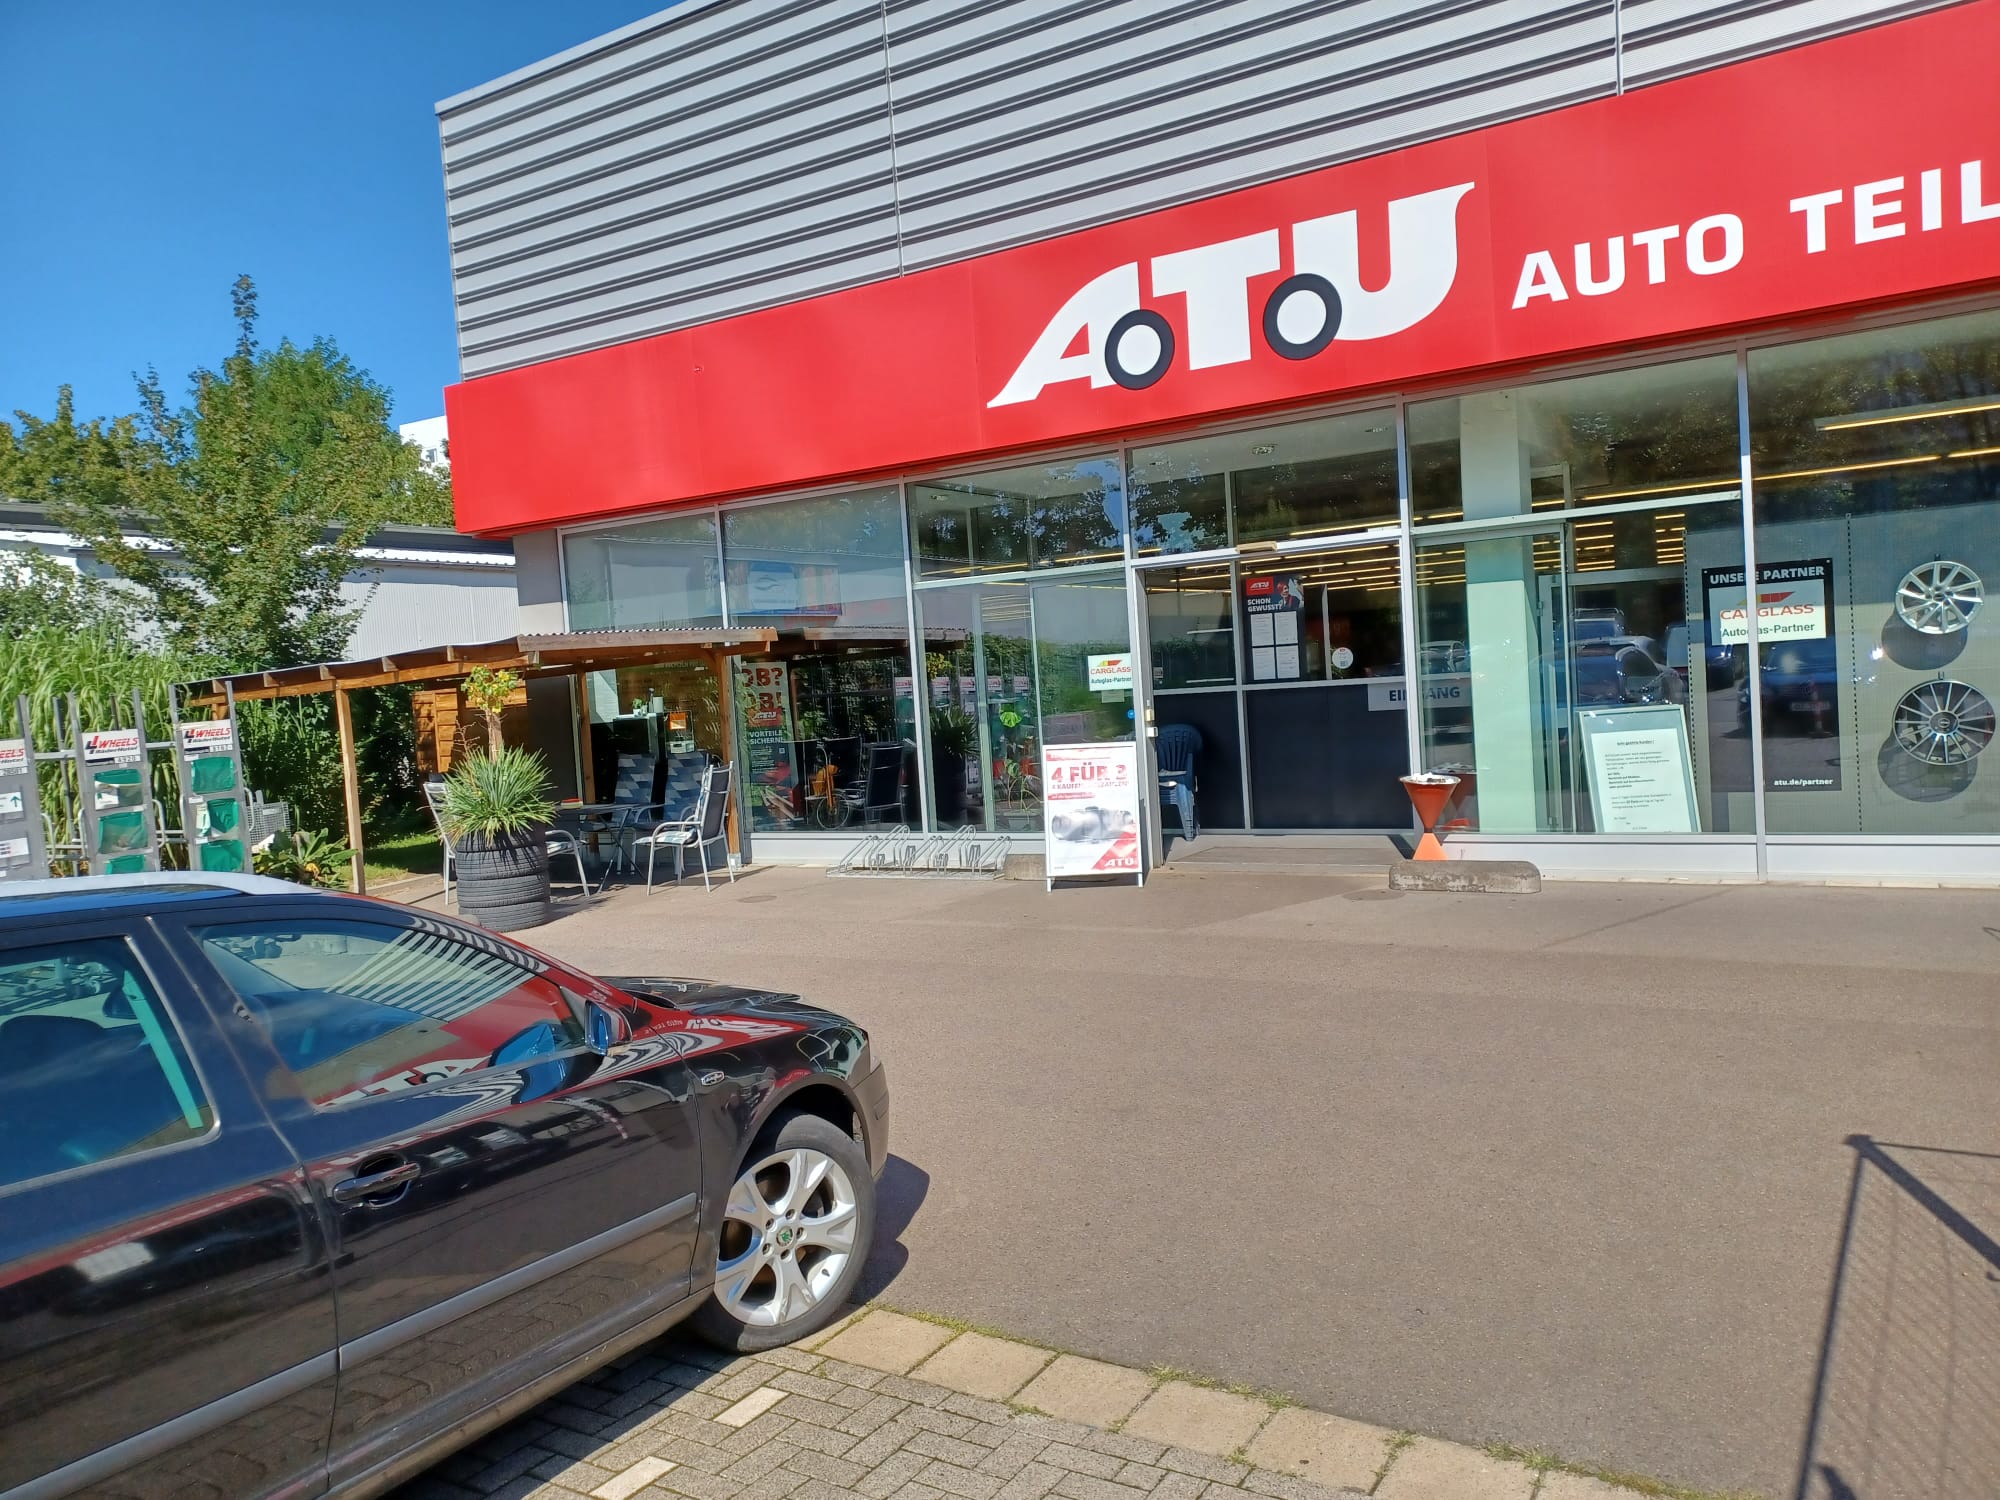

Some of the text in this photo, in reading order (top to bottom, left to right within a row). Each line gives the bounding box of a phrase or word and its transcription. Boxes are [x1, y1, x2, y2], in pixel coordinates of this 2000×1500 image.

[987, 159, 2000, 408] ATU AUTO TEIL
[1710, 565, 1825, 584] UNSE PARTNER
[1247, 597, 1271, 606] SCHON
[1247, 603, 1284, 612] GEWUSST?
[1720, 604, 1815, 620] CAGLASS
[1721, 623, 1816, 638] Autoas-Partner
[1090, 666, 1132, 675] CARGLASS
[1388, 686, 1461, 702] EIANG
[749, 729, 783, 738] VORTEILE
[749, 736, 784, 745] SICHERN!
[1051, 766, 1064, 783] 4
[1069, 761, 1108, 783] FÜR
[1773, 778, 1834, 787] atu.de/partner
[1103, 857, 1135, 868] ATU
